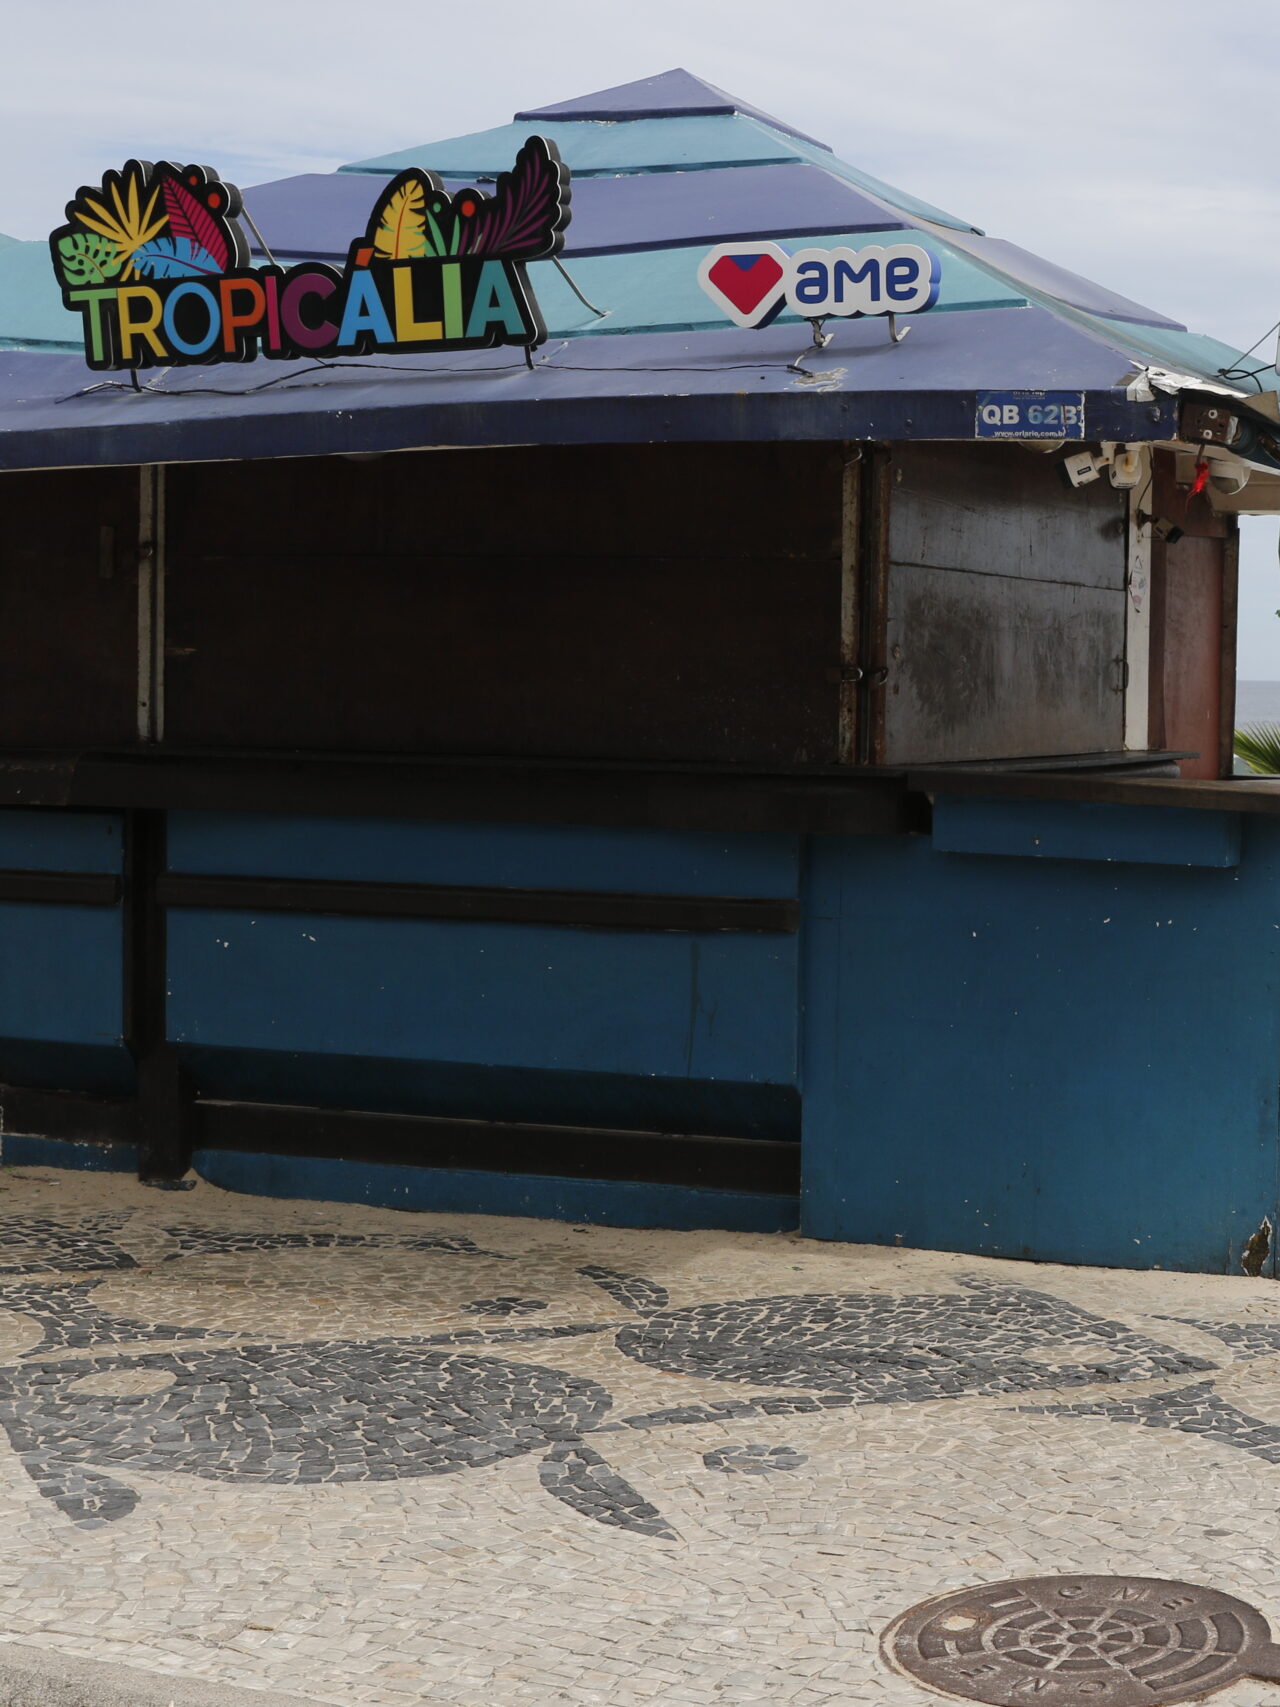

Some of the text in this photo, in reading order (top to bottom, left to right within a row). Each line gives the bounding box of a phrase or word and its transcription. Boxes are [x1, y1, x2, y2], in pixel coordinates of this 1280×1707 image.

[70, 247, 527, 362] TROPICÁLIA
[982, 404, 1078, 425] QB 62B
